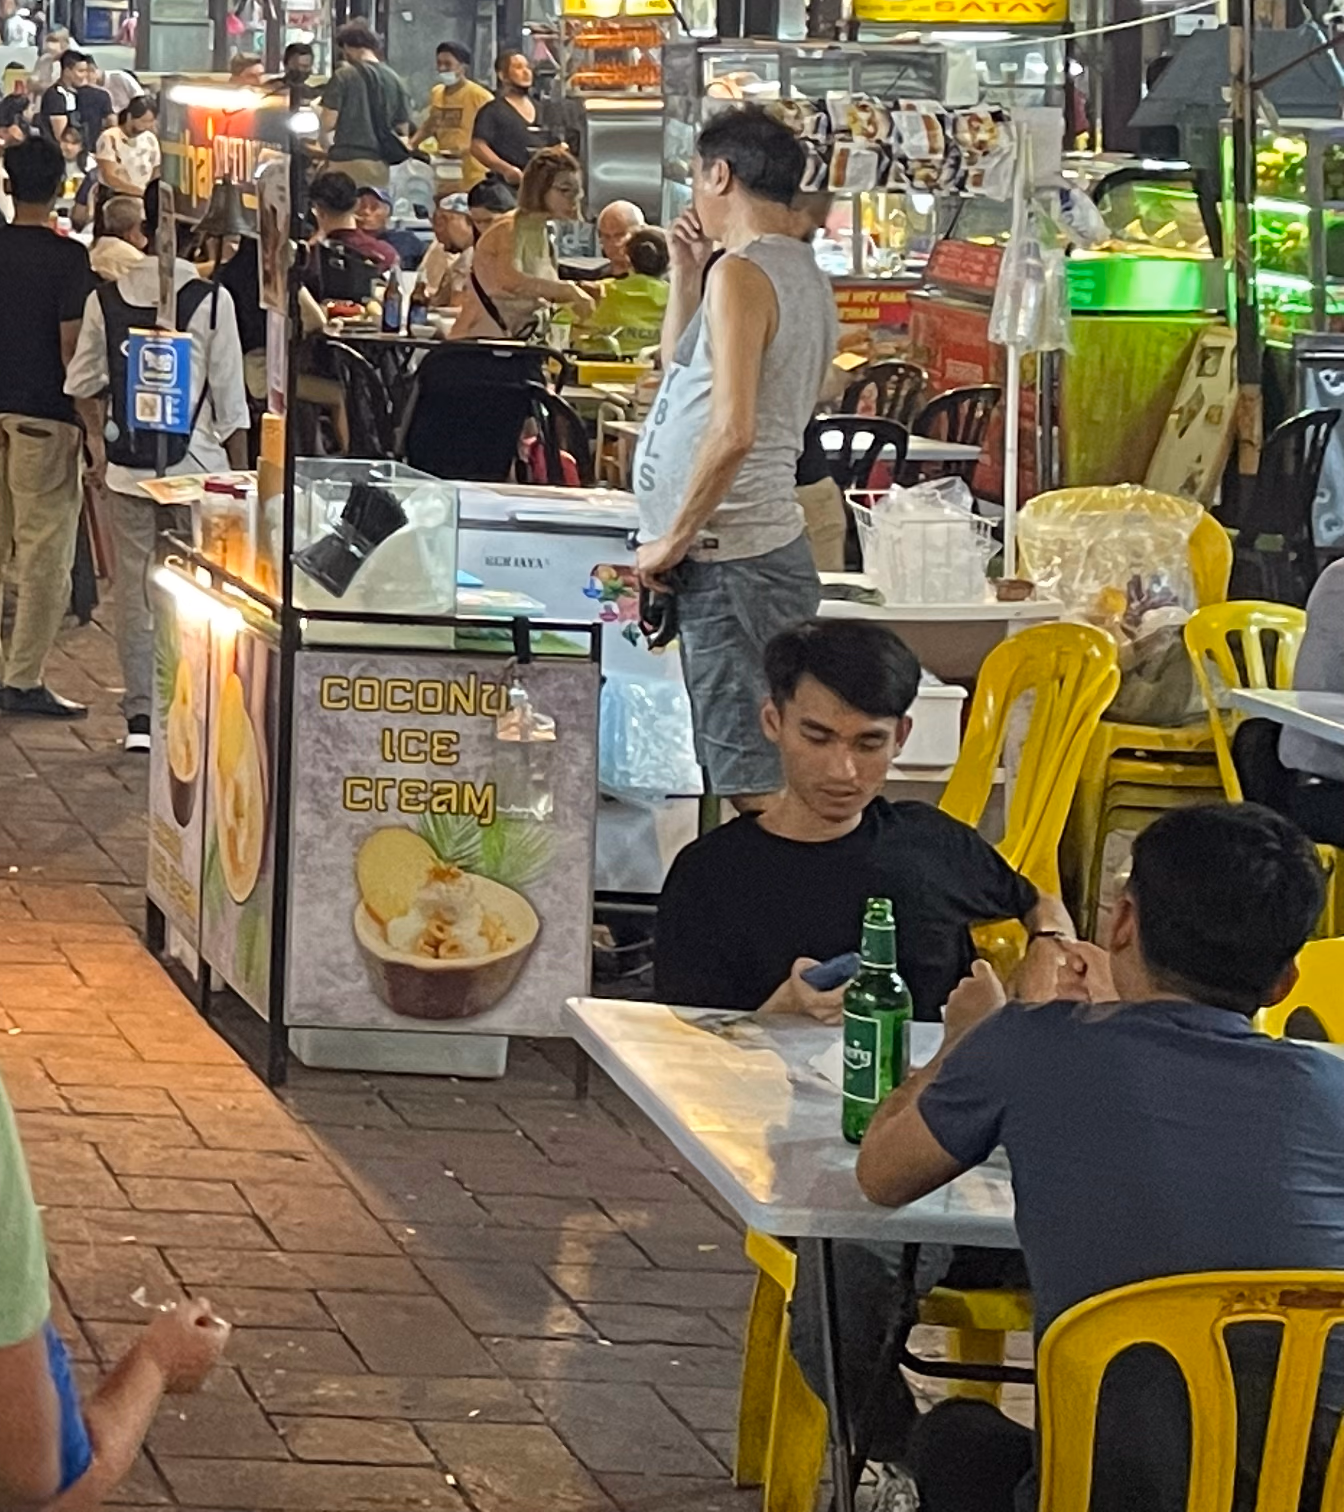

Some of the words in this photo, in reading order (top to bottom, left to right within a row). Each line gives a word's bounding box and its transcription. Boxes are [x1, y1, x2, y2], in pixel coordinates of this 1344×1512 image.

[935, 1, 1057, 13] SATAY
[320, 672, 512, 716] COCONU
[381, 728, 460, 765] ICE
